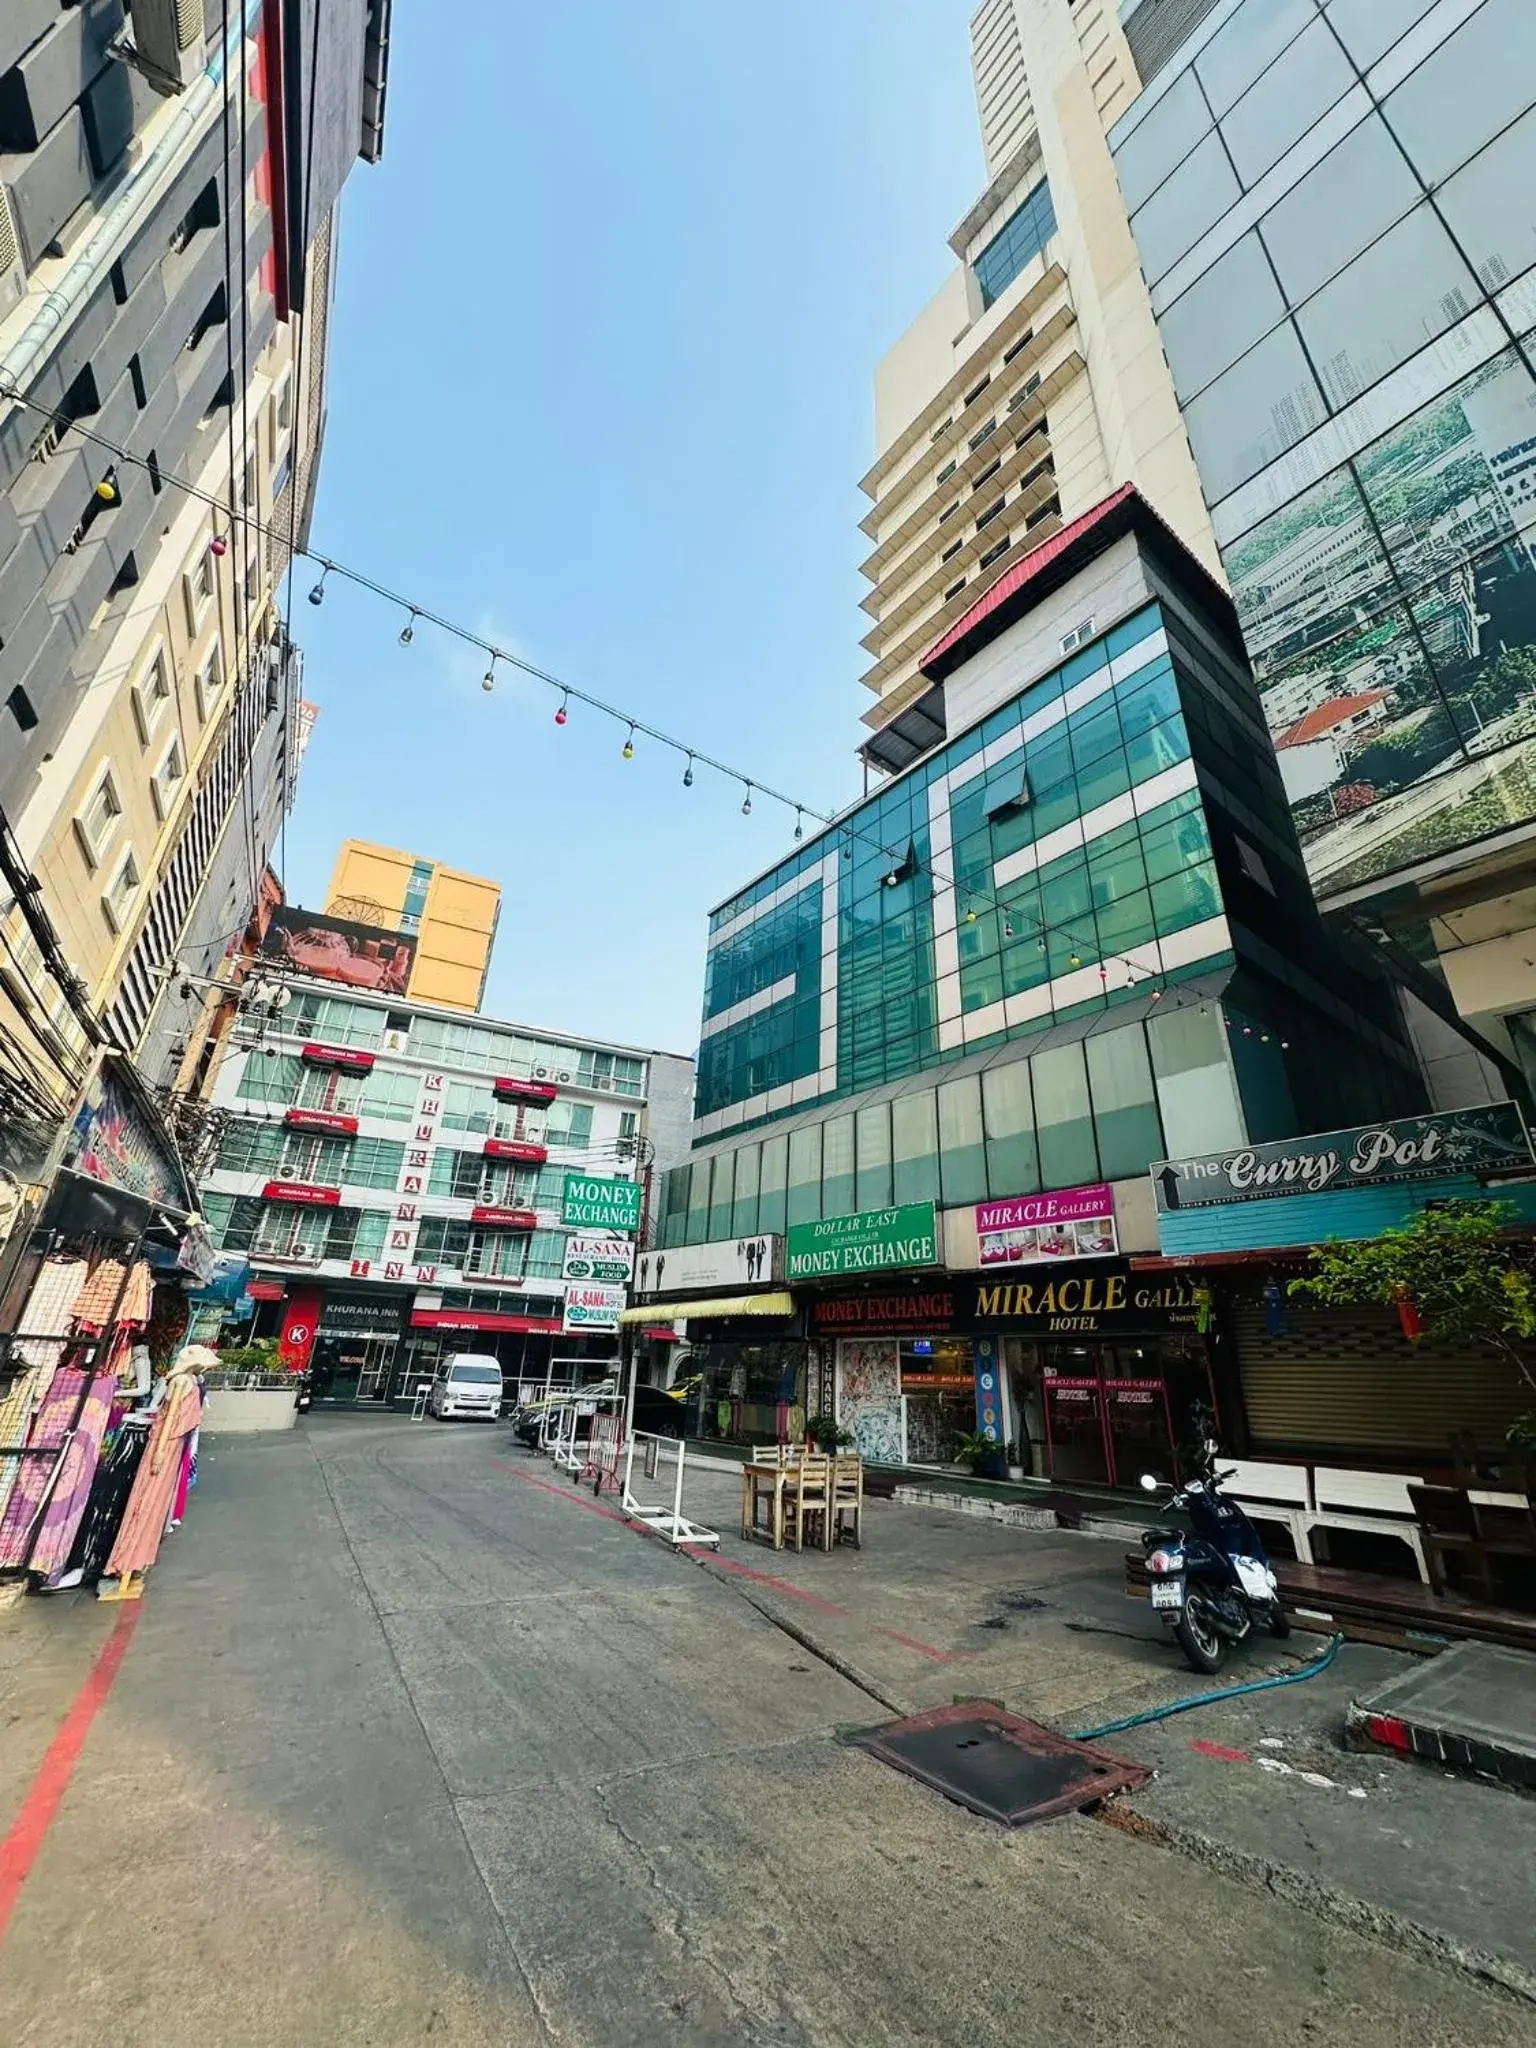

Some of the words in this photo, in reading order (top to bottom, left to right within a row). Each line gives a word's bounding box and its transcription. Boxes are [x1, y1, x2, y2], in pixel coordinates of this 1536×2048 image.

[1179, 1161, 1219, 1180] The
[1223, 1152, 1340, 1191] Curry
[1350, 1128, 1442, 1173] Pot
[568, 1181, 637, 1205] MONEY
[565, 1202, 637, 1226] EXCHANGE
[814, 1218, 861, 1237] DOLLAR
[865, 1211, 900, 1229] EAST
[980, 1200, 1058, 1228] MIRACLE
[1060, 1200, 1106, 1216] GALLERY
[568, 1240, 631, 1257] AL-SANA
[791, 1247, 841, 1274] MONEY
[844, 1236, 932, 1268] EXCHANGE
[596, 1261, 627, 1273] MUSLIM
[601, 1271, 622, 1279] FOOD
[568, 1289, 606, 1307] AL-SANA
[813, 1300, 866, 1322] MONEY
[867, 1294, 954, 1319] EXCHANGE
[974, 1275, 1127, 1317] MIRACLE
[326, 1304, 379, 1315] KHURANA
[381, 1308, 399, 1317] INN
[1049, 1316, 1099, 1330] HOTEL
[1117, 1391, 1153, 1403] HOTEL
